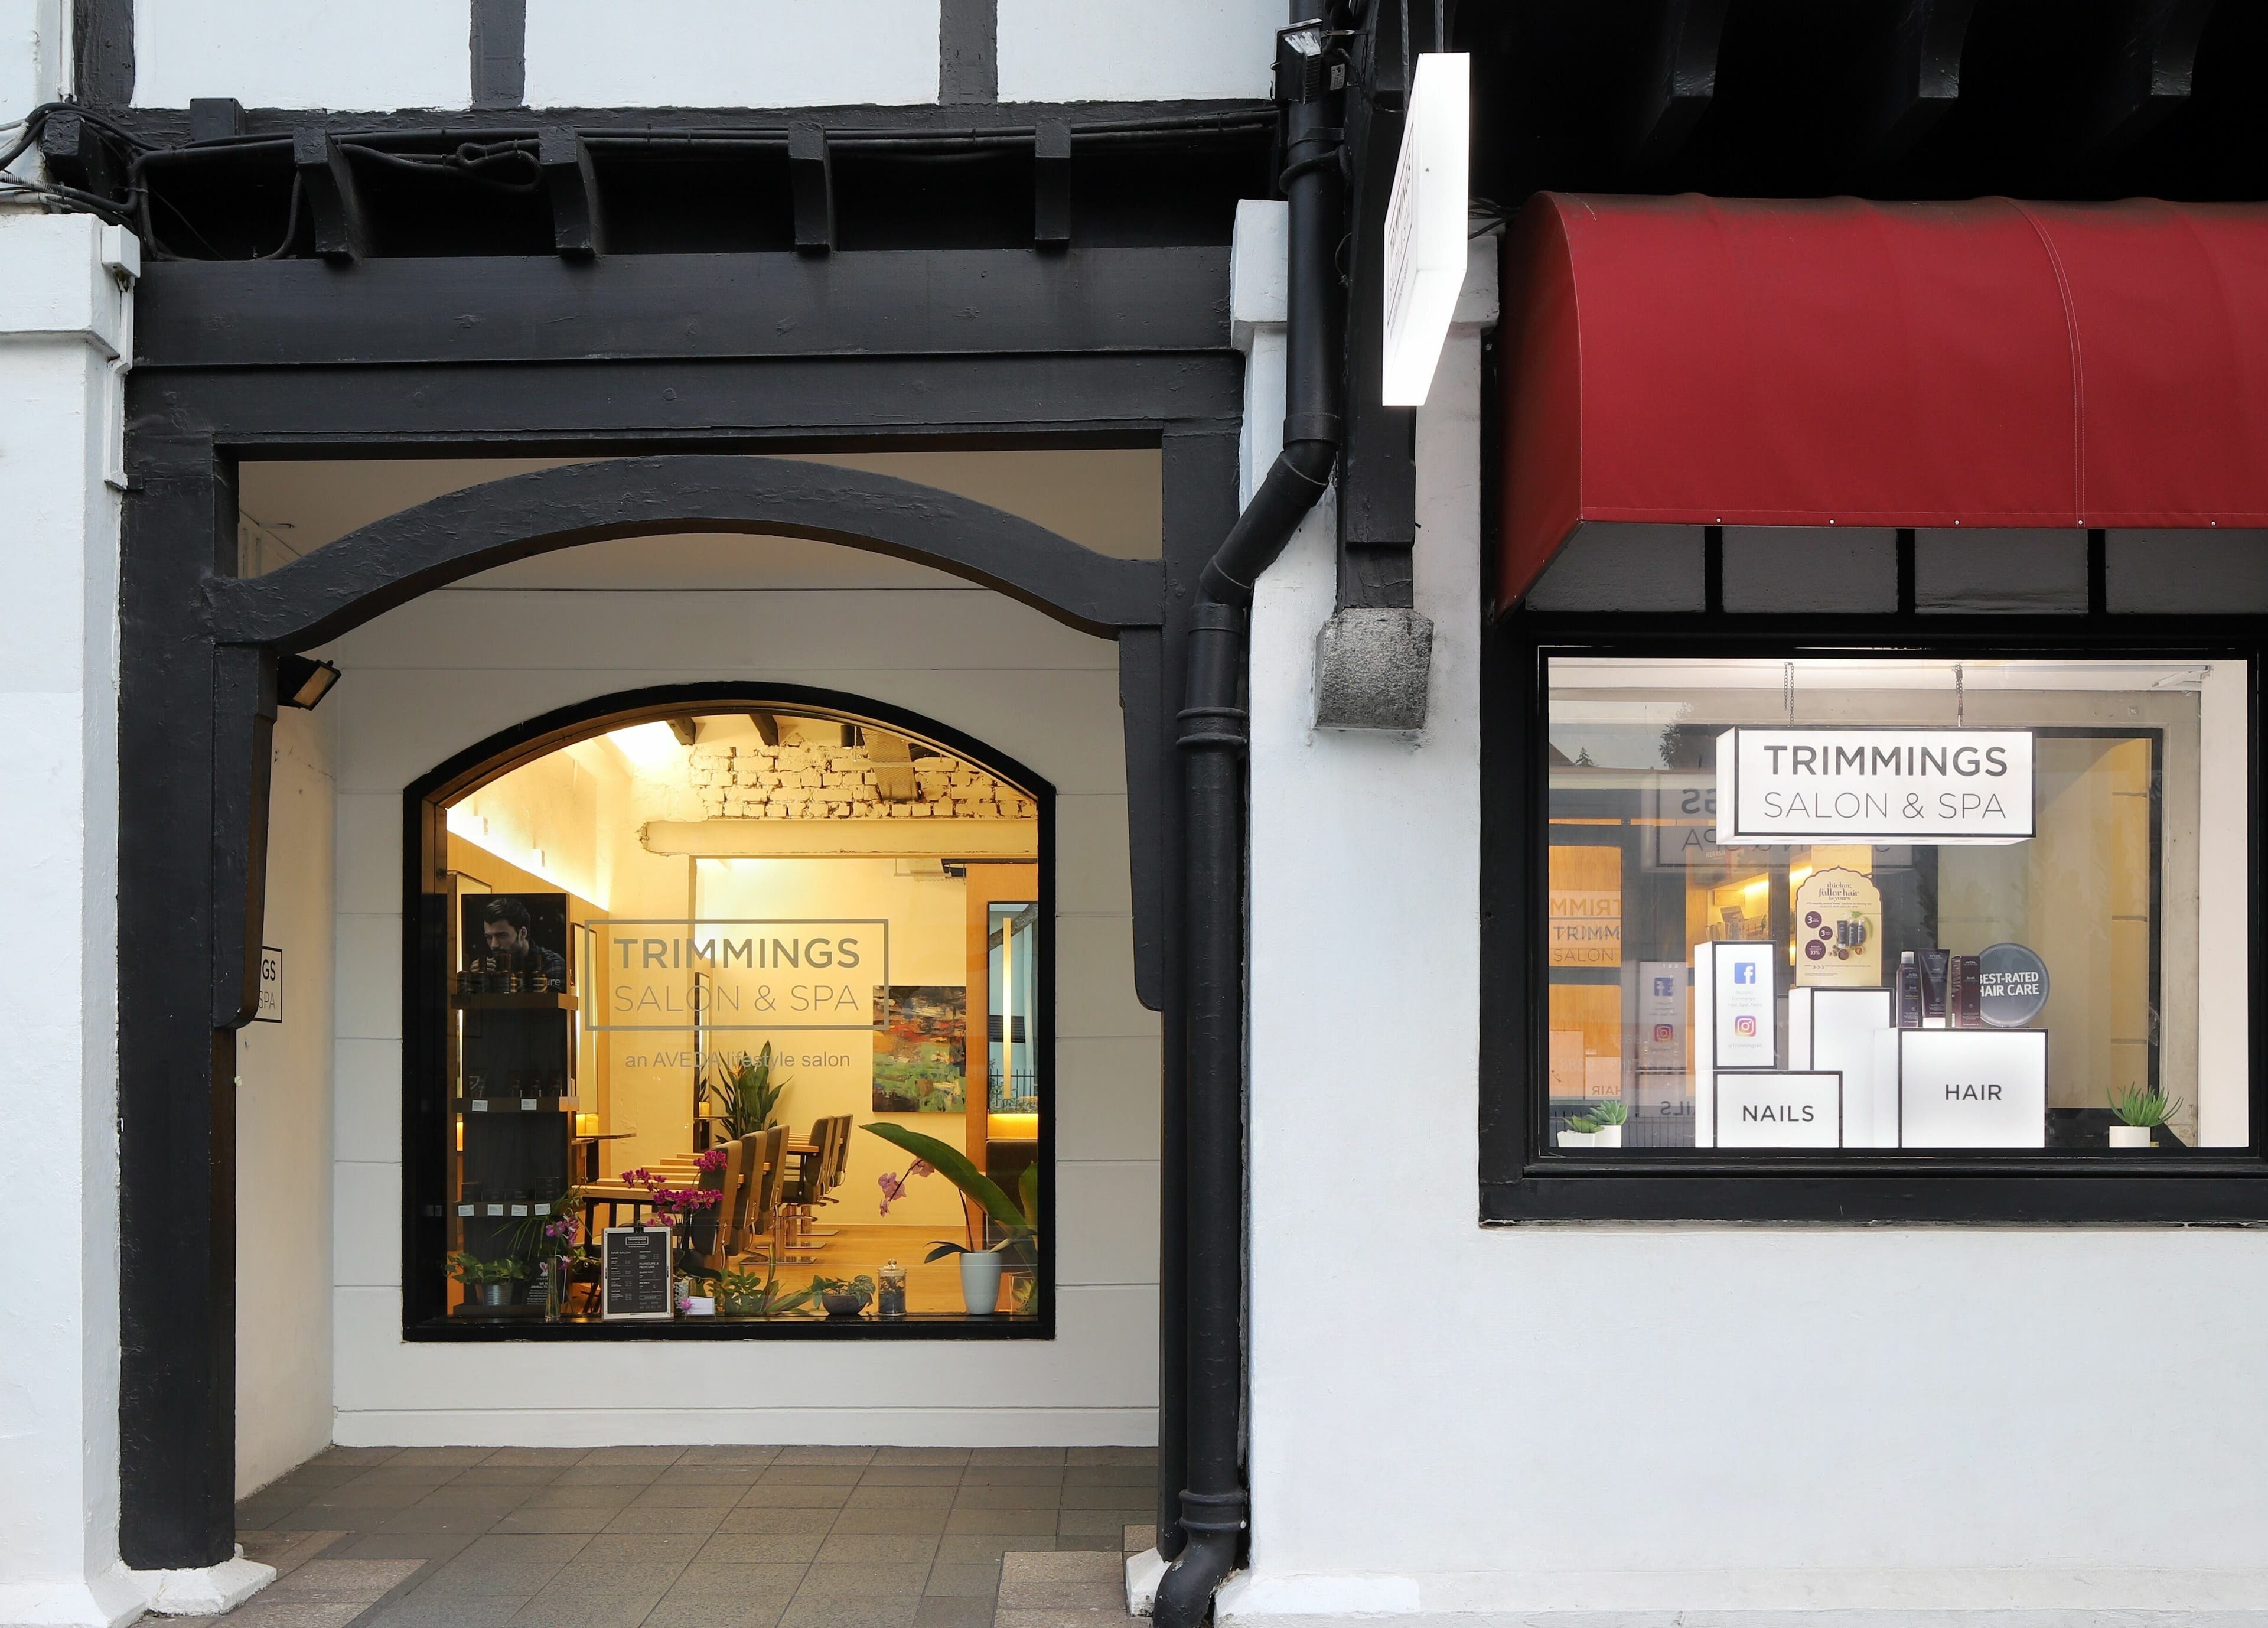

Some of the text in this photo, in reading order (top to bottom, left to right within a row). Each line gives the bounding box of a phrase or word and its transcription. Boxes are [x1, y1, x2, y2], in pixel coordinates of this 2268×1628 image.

[1764, 745, 2007, 776] TRIMMINGS
[1764, 792, 2006, 819] SALON & SPA
[1843, 888, 1859, 896] hair
[614, 937, 860, 969] TRIMMINGS
[1553, 948, 1614, 962] SALON
[262, 959, 276, 981] GS
[615, 985, 859, 1011] SALON & SPA
[2007, 984, 2040, 996] CARE
[625, 1051, 850, 1072] an AVEDA lifestyle salon
[1945, 1083, 2002, 1101] HAIR
[1742, 1105, 1815, 1122] NAILS
